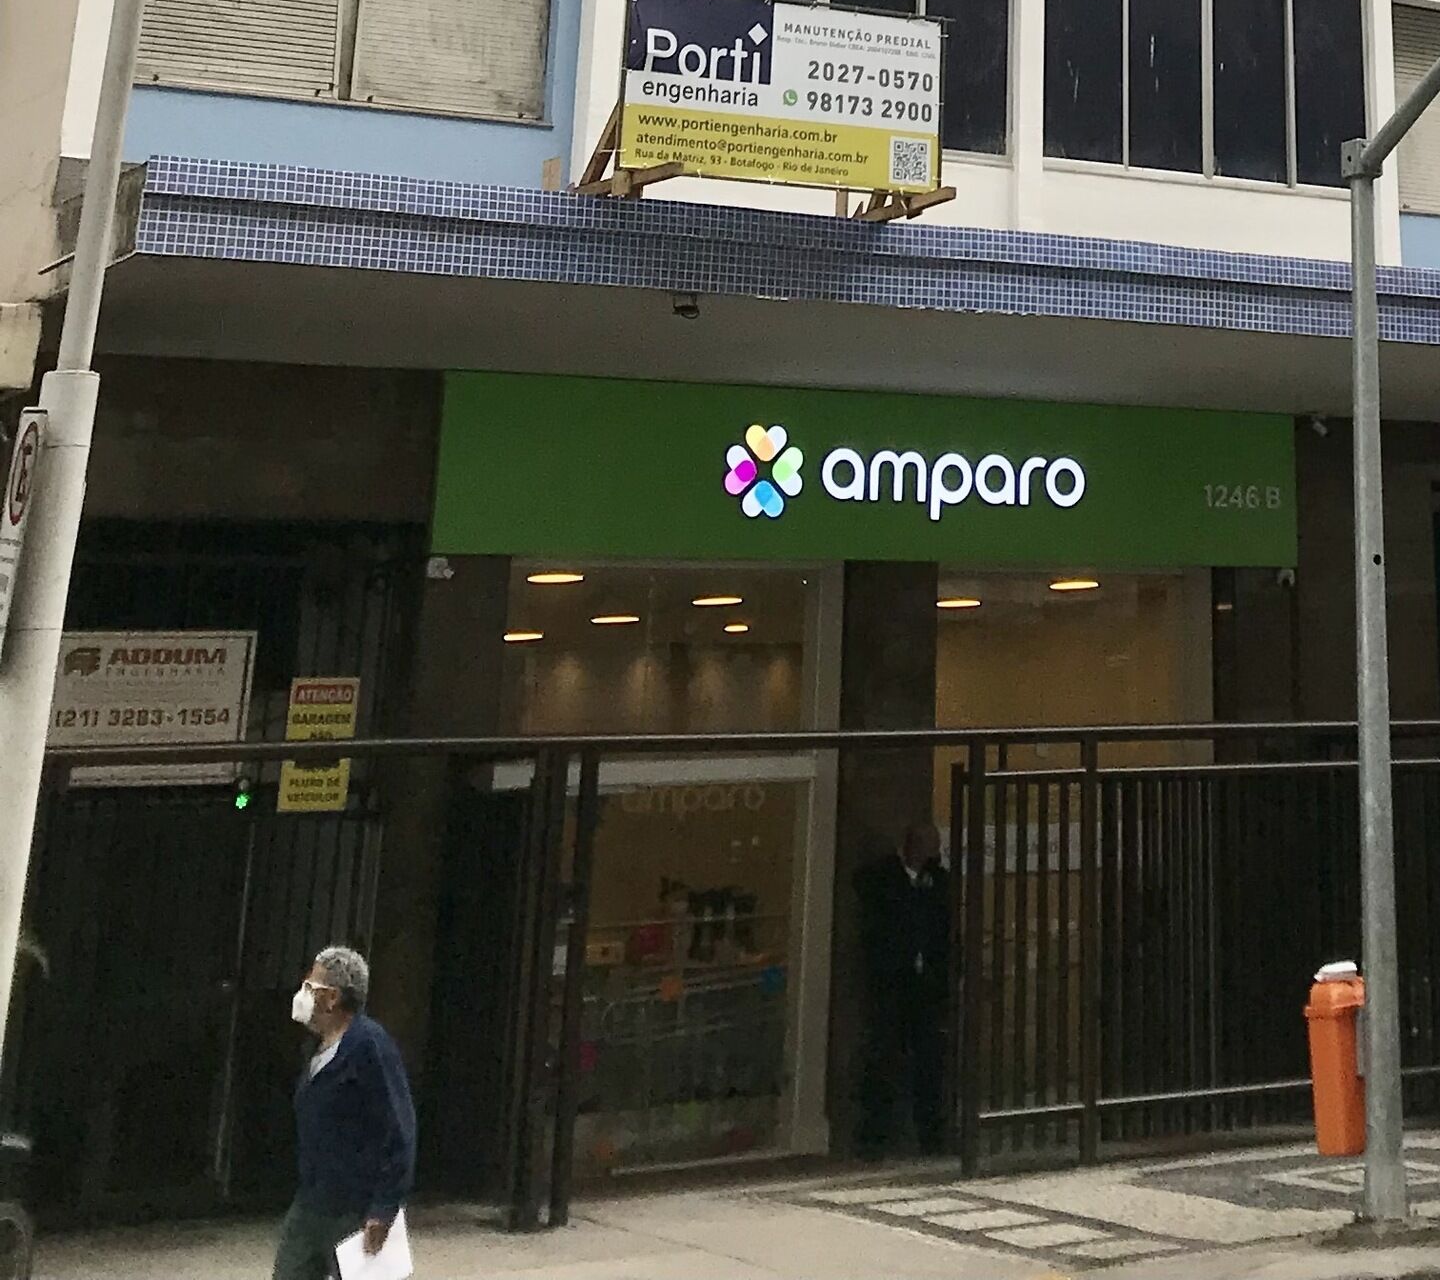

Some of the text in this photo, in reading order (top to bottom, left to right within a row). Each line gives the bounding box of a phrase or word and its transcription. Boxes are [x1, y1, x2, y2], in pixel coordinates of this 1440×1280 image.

[784, 22, 872, 43] MANUTENÇÃO
[876, 33, 931, 50] PREDIAL
[643, 22, 769, 85] Porti
[808, 60, 933, 92] 2027-0570
[642, 80, 758, 107] engenharia
[807, 91, 932, 122] 98173 2900
[638, 113, 838, 143] www.portiengenharia.com.br
[635, 148, 655, 160] Rua
[657, 151, 669, 160] da
[672, 152, 707, 165] Matriz,
[730, 157, 775, 171] Botafogo
[783, 161, 798, 172] Rio
[800, 163, 813, 173] de
[815, 165, 849, 177] Janeiro
[636, 132, 869, 165] atendimento@portiengenharia.com.br
[821, 446, 1086, 521] amparo
[1204, 484, 1281, 509] 1246 B
[297, 686, 352, 701] ATENÇÃO
[55, 709, 99, 728] (21)
